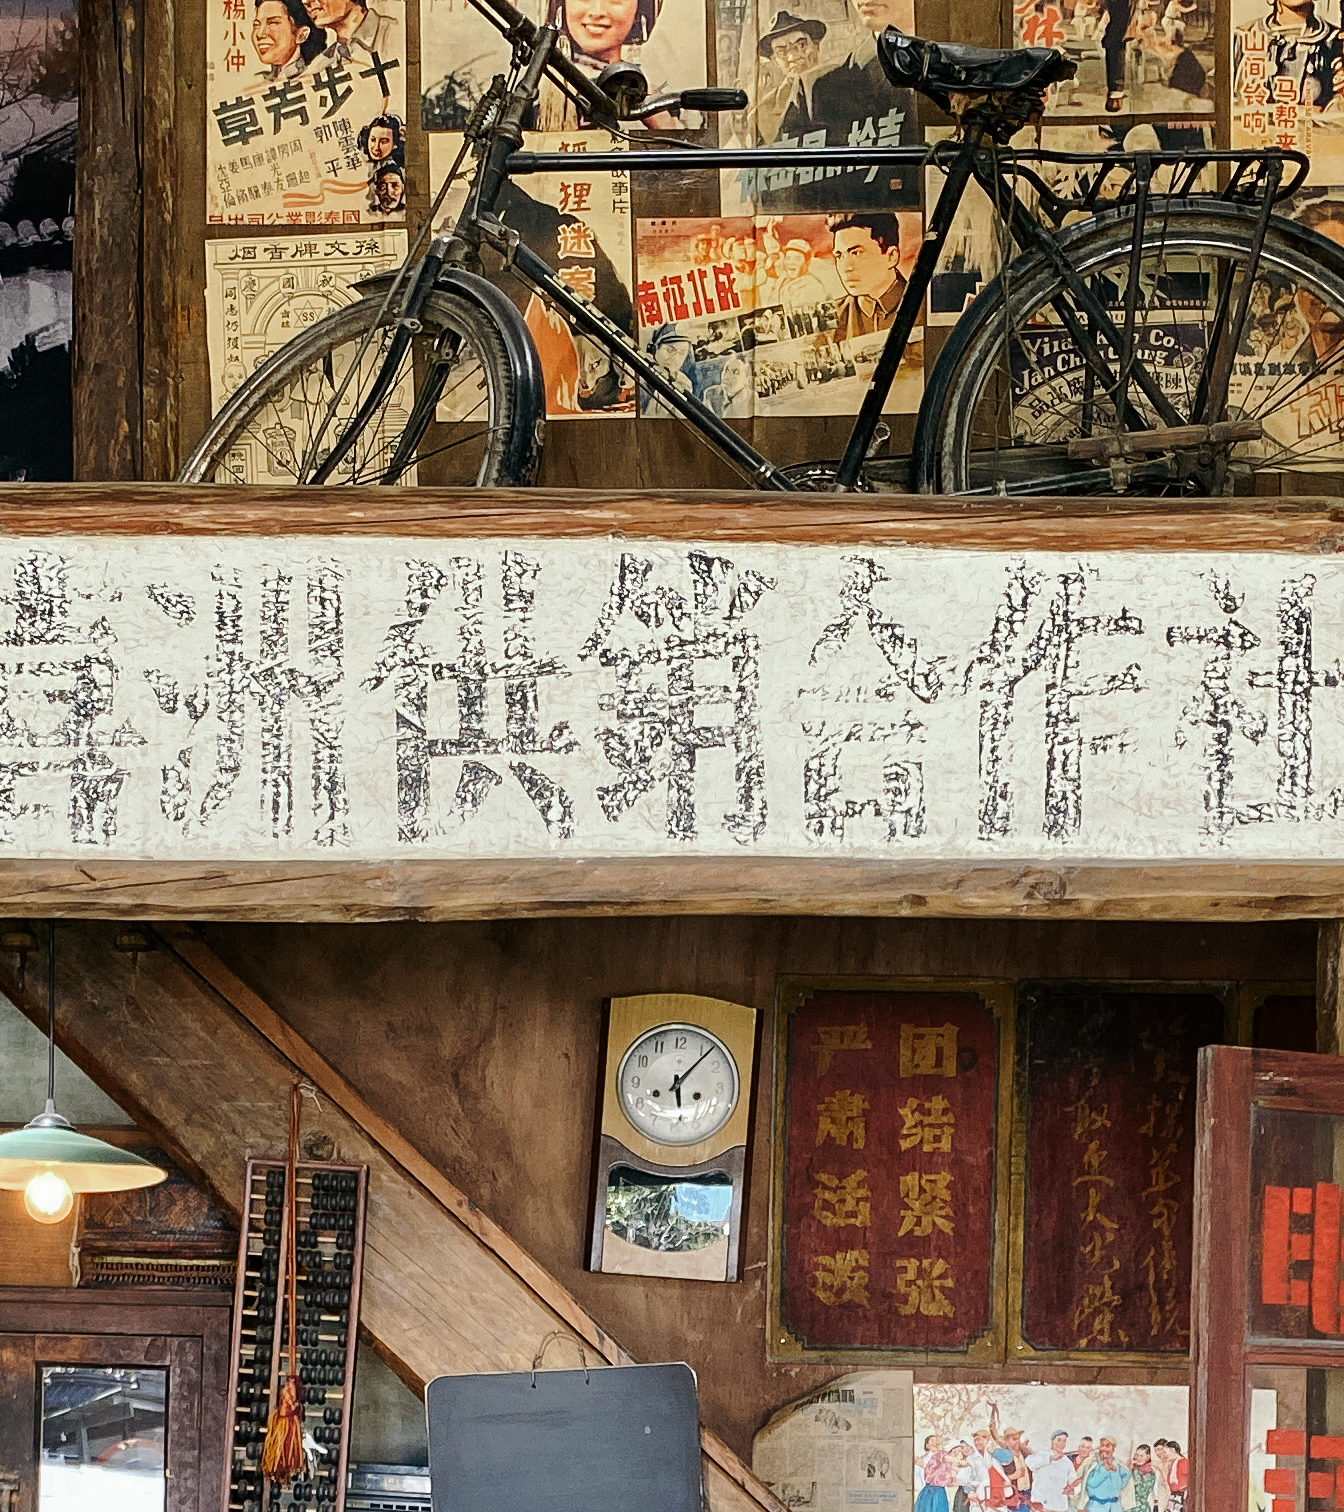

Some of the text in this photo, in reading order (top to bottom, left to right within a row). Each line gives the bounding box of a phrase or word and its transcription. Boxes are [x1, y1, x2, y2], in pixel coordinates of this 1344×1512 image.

[212, 51, 400, 147] 十步芳草
[1242, 31, 1268, 134] 山间铃响
[1273, 75, 1298, 150] 马帮来
[228, 238, 382, 261] 孫文牌香烟
[638, 263, 741, 328] 南征北战
[895, 1023, 959, 1318] 团结紧张
